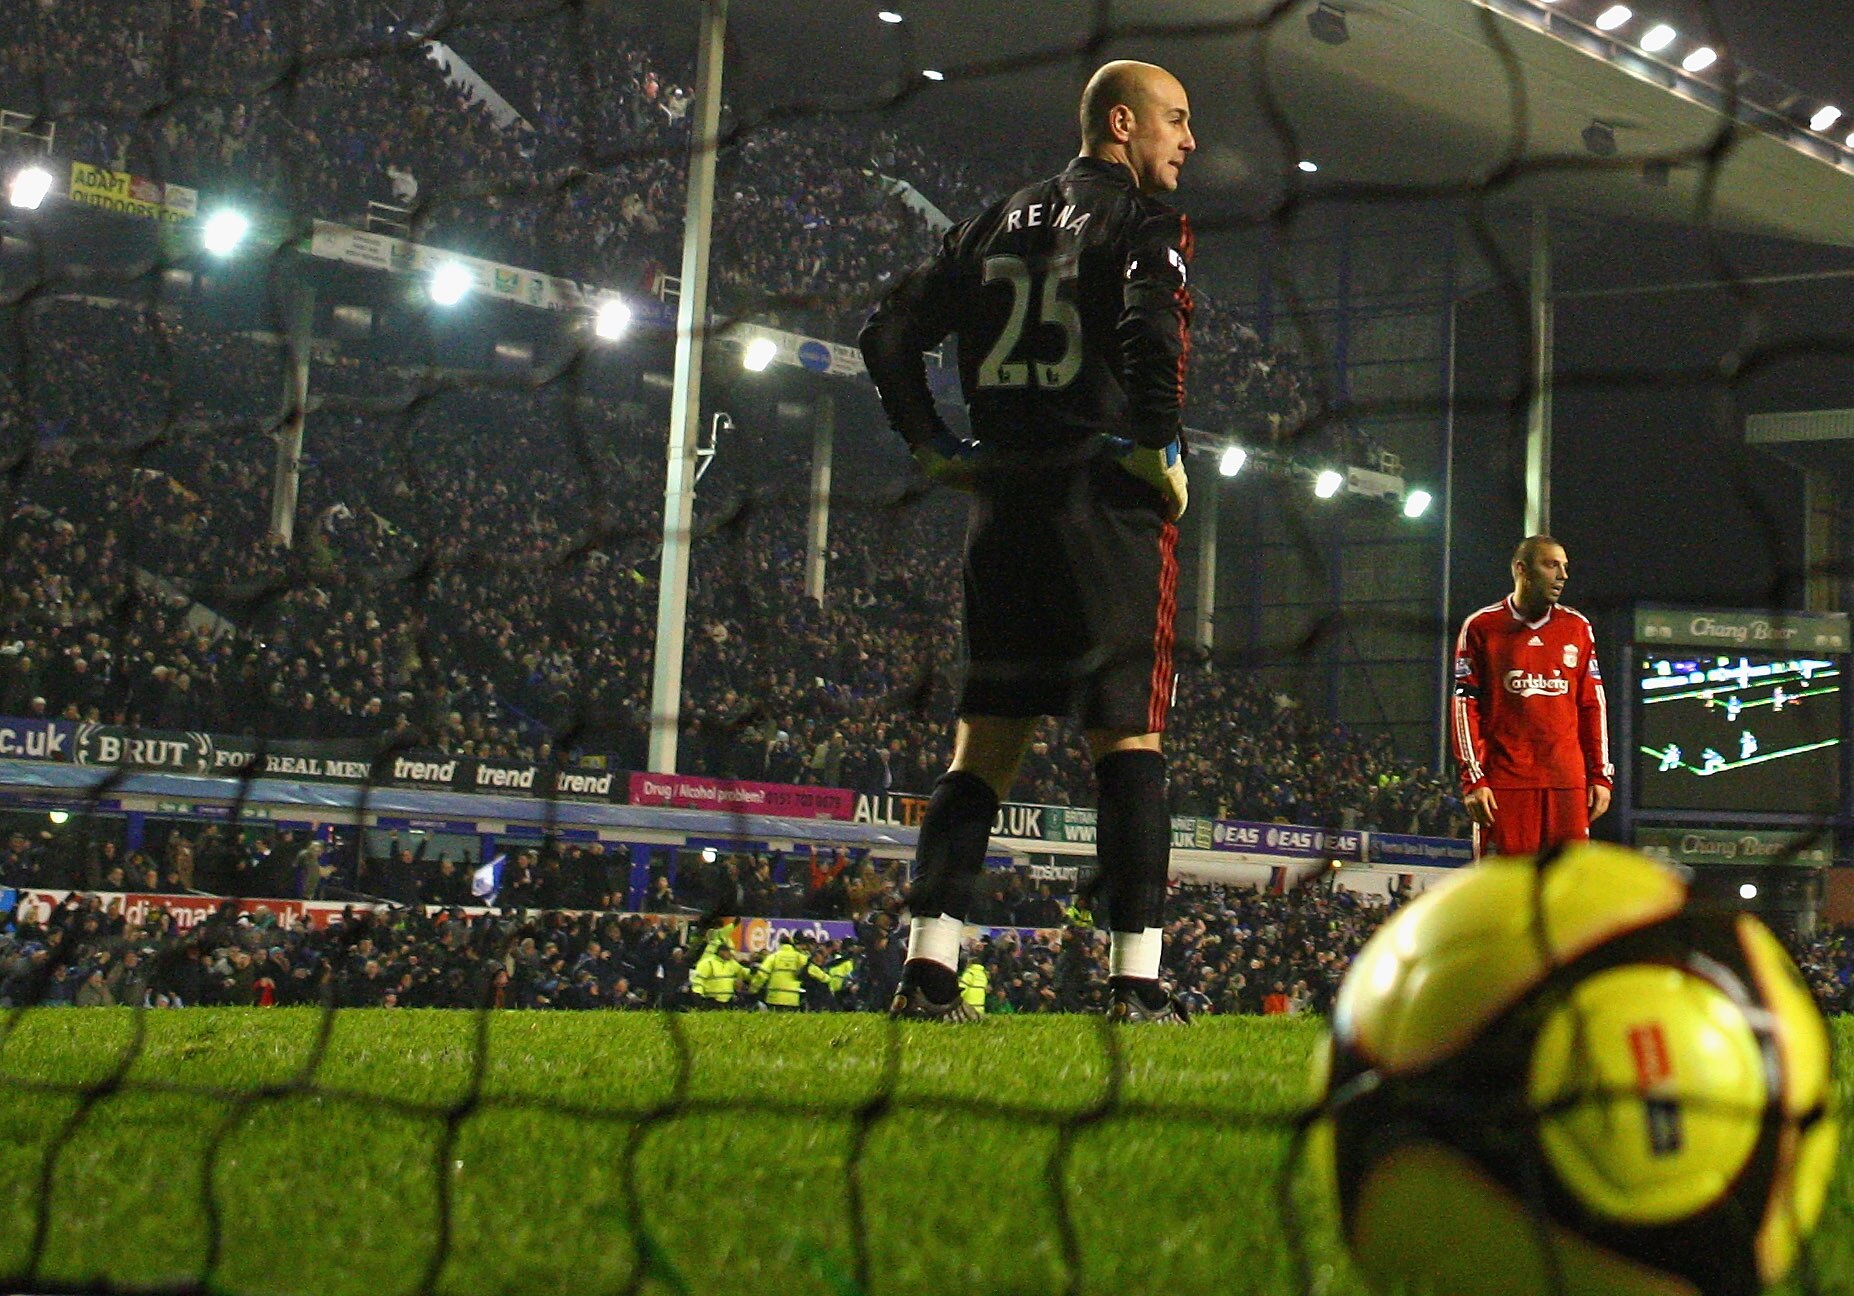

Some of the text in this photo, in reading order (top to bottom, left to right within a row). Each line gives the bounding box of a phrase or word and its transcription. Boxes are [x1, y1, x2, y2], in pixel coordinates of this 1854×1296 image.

[976, 253, 1082, 389] 25
[1503, 669, 1570, 697] Carlsberg
[100, 735, 189, 766] BRUT
[265, 754, 323, 775] REAL
[325, 760, 372, 779] MEN
[393, 756, 456, 782] trend
[476, 763, 535, 788] trend
[557, 771, 612, 794] trend
[643, 780, 672, 800] Drug
[679, 784, 717, 801] Alcohol
[717, 788, 765, 805] problem?
[1224, 825, 1261, 844] EAS
[1278, 831, 1314, 848] EAS
[1323, 834, 1358, 852] EAS
